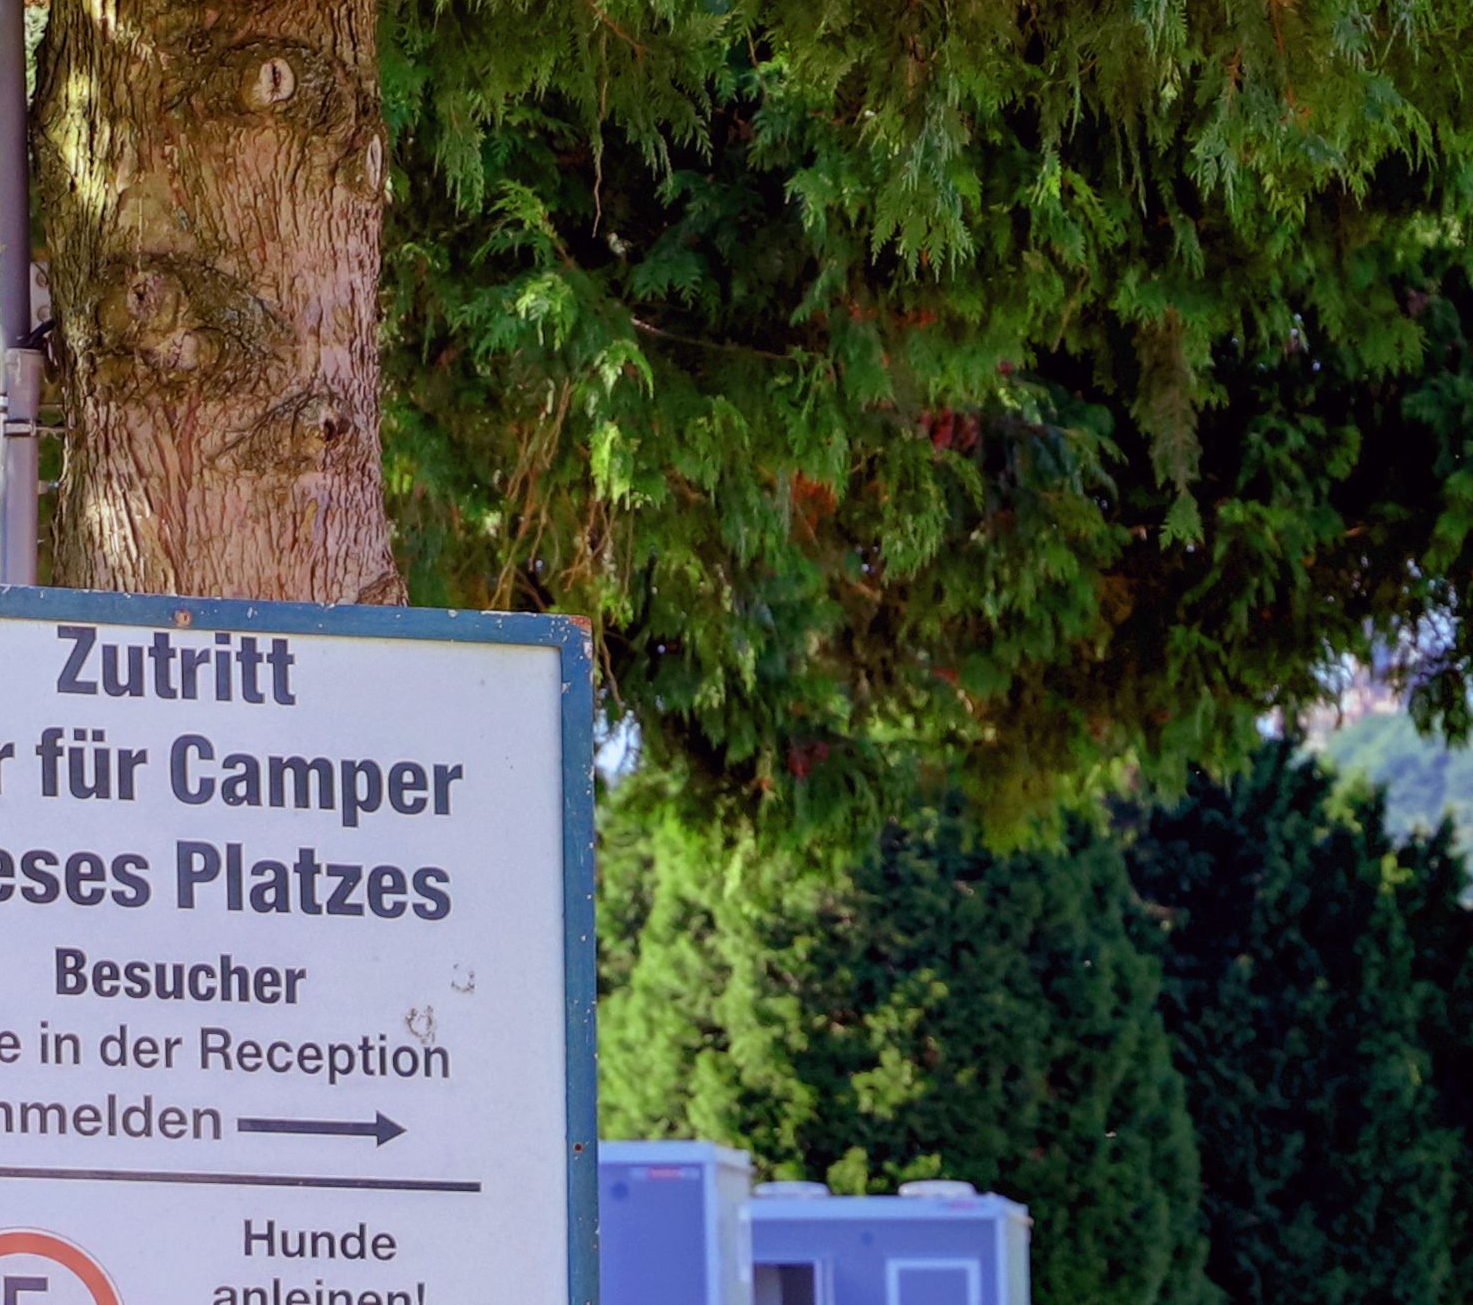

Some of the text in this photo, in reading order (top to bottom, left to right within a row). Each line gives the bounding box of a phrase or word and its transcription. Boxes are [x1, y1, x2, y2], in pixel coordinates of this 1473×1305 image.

[57, 626, 296, 705] Zutritt
[36, 728, 147, 800] für
[170, 735, 463, 827] Camper
[177, 841, 450, 920] Platzes
[56, 948, 306, 1003] Besucher
[41, 1021, 80, 1064] in
[100, 1025, 182, 1068] der
[201, 1025, 449, 1085] Reception
[245, 1220, 396, 1260] Hunde
